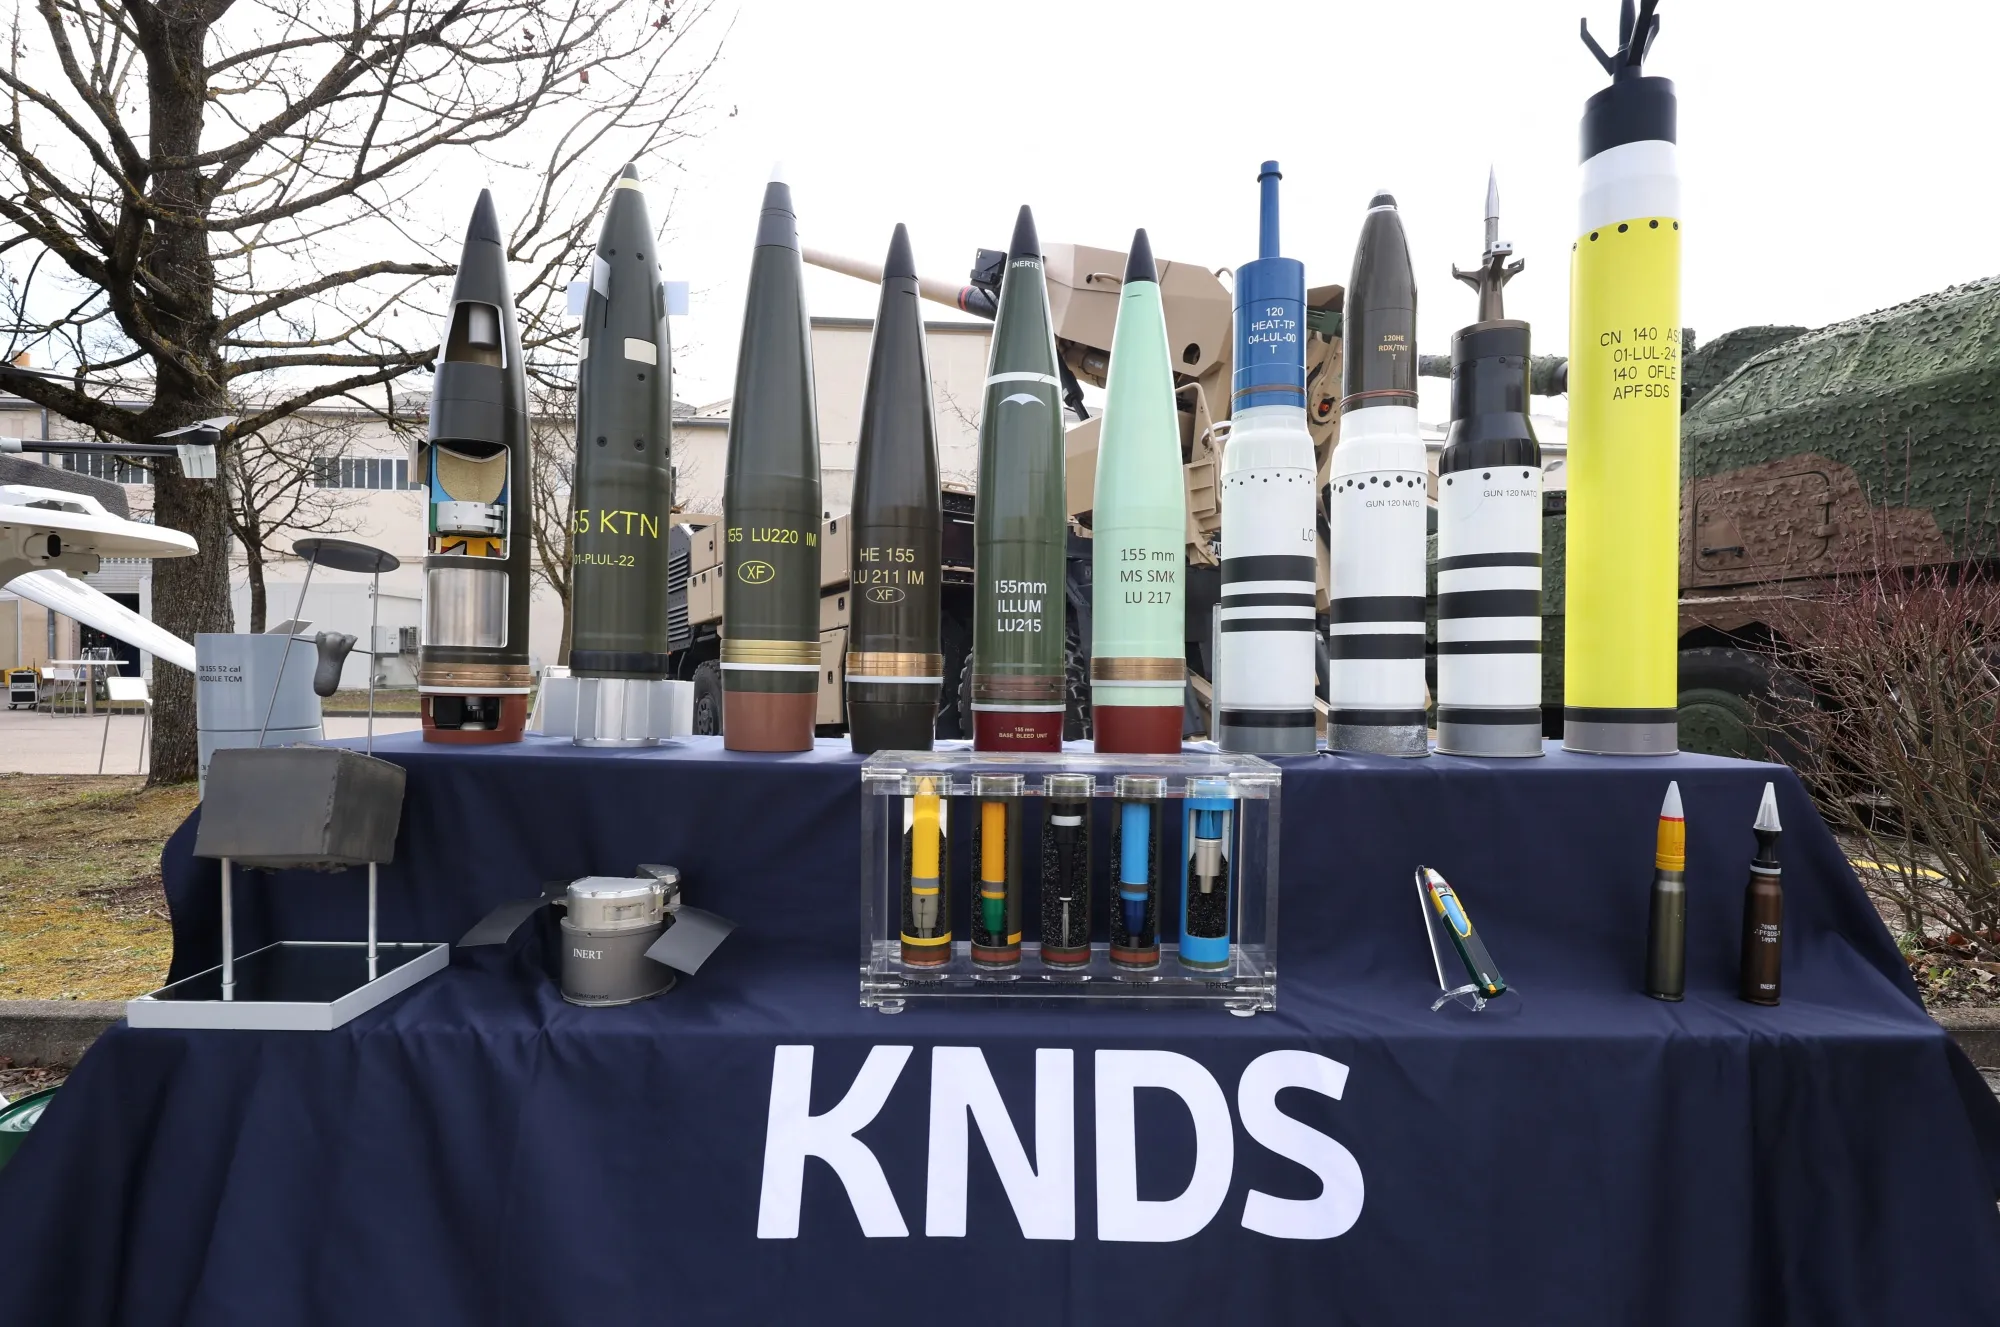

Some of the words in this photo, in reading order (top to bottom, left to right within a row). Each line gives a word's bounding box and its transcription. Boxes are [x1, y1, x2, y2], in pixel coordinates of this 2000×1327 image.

[1012, 260, 1039, 270] INERTE
[1265, 307, 1284, 317] 120
[1251, 319, 1296, 332] HEAT-TP
[1248, 332, 1297, 345] 04-LUL-00
[1383, 334, 1405, 342] 120HE
[1600, 330, 1622, 347] CN
[1633, 327, 1658, 341] 140
[1270, 344, 1277, 354] T
[1378, 343, 1409, 352] RDX/TNT
[1613, 346, 1677, 363] 01-LUL-24
[1613, 366, 1638, 382] 140
[1648, 365, 1676, 381] OFLE
[1613, 384, 1670, 401] APFSDS
[1483, 489, 1503, 498] GUN
[1506, 489, 1519, 497] 120
[1520, 489, 1537, 498] NATO
[1366, 500, 1385, 508] GUN
[1402, 500, 1420, 508] NATO
[600, 509, 658, 539] KTN
[752, 527, 799, 544] LU220
[806, 531, 817, 547] IM
[1302, 528, 1316, 542] LO
[860, 547, 880, 562] HE
[886, 547, 915, 563] 155
[1120, 548, 1146, 561] 155
[1151, 551, 1175, 562] mm
[747, 565, 766, 579] XF
[853, 569, 868, 584] LU
[872, 569, 899, 584] 211
[907, 569, 924, 585] IM
[1120, 569, 1143, 583] MS
[1147, 569, 1175, 583] SMK
[995, 580, 1047, 594] 155mm
[876, 589, 894, 600] XF
[1125, 591, 1142, 604] LU
[1148, 591, 1171, 604] 217
[997, 599, 1041, 613] ILLUM
[997, 618, 1042, 633] LU215
[218, 665, 227, 673] 52
[229, 665, 241, 673] cal
[224, 675, 243, 683] TCM
[573, 947, 604, 960] INERT
[757, 1045, 1364, 1242] KNDS
